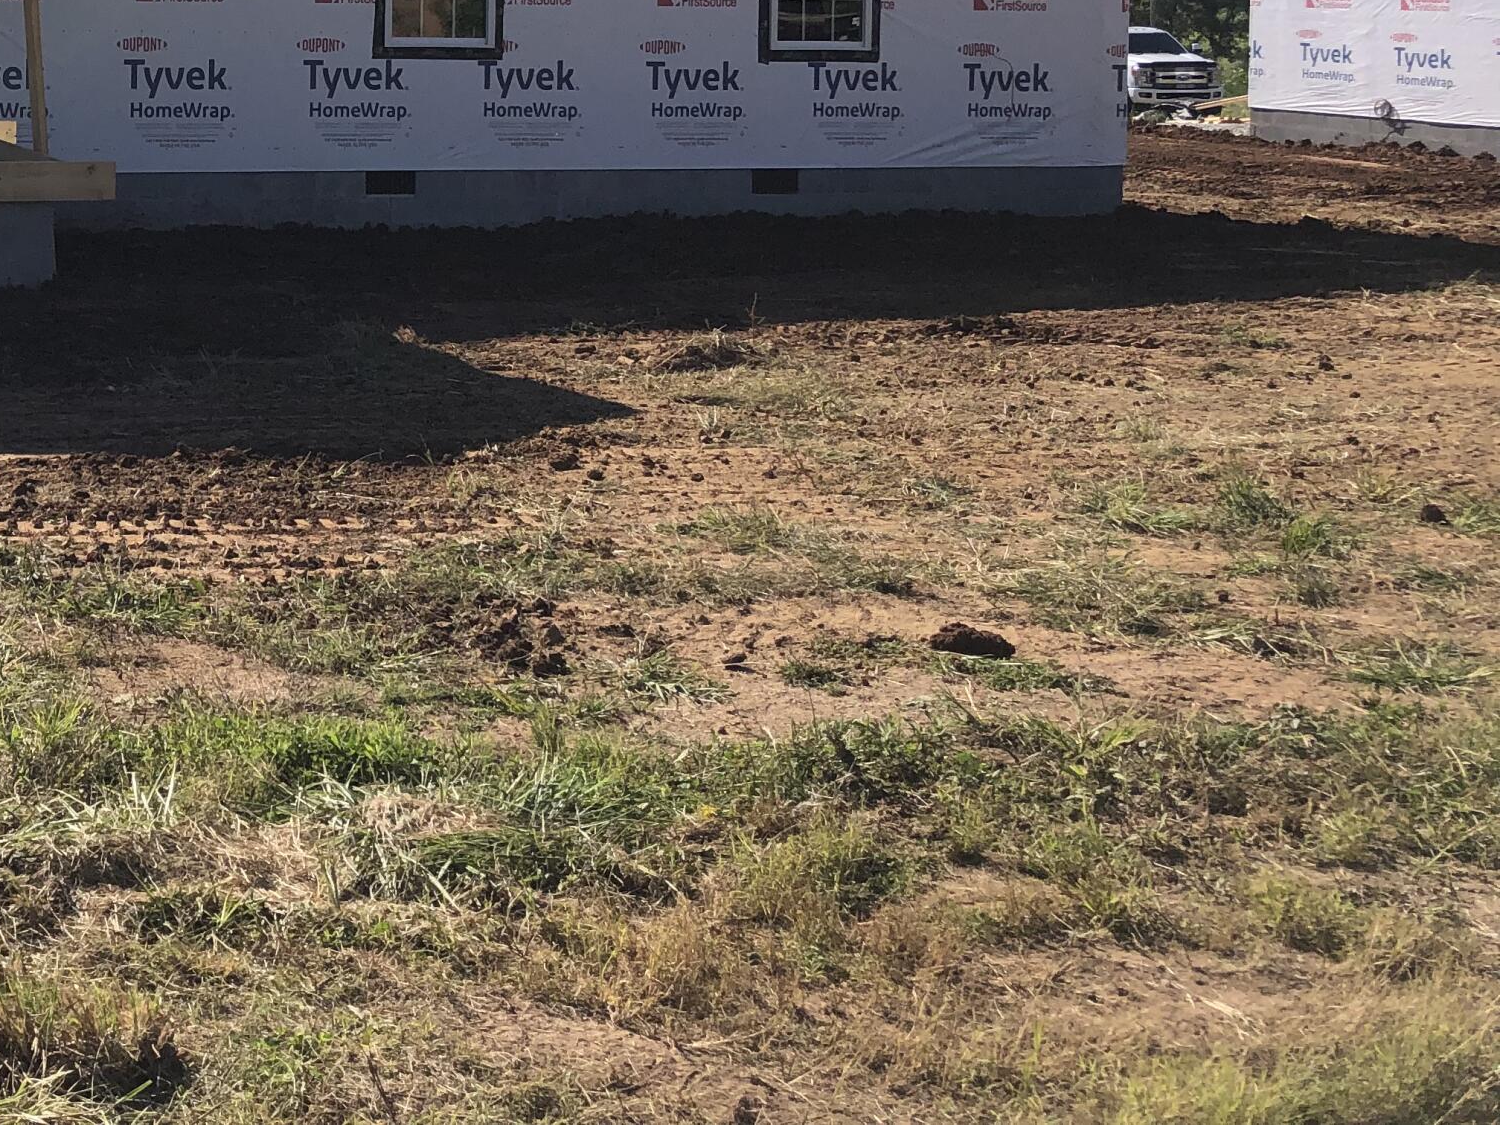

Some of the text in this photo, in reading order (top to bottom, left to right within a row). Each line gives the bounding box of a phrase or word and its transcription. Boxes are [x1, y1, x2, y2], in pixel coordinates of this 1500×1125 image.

[996, 0, 1046, 12] FirstSource
[123, 37, 162, 52] DUPONT
[302, 38, 340, 53] DUPONT
[645, 40, 681, 54] DUPONT
[963, 43, 996, 57] DUPONT
[1300, 42, 1352, 67] Tyvek
[1394, 47, 1451, 72] Tyvek
[124, 59, 228, 98] Tyvek
[303, 60, 404, 98] Tyvek
[478, 60, 575, 98] Tyvek
[647, 62, 740, 98] Tyvek
[808, 63, 898, 98] Tyvek
[964, 63, 1049, 99] Tyvek
[1302, 68, 1354, 82] HomeWrap
[1397, 75, 1454, 88] HomeWrap
[130, 102, 231, 120] HomeWrap
[309, 102, 407, 120] HomeWrap
[484, 102, 578, 120] HomeWrap
[652, 103, 743, 120] HomeWrap
[813, 103, 900, 120] HomeWrap
[968, 103, 1051, 121] HomeWrap
